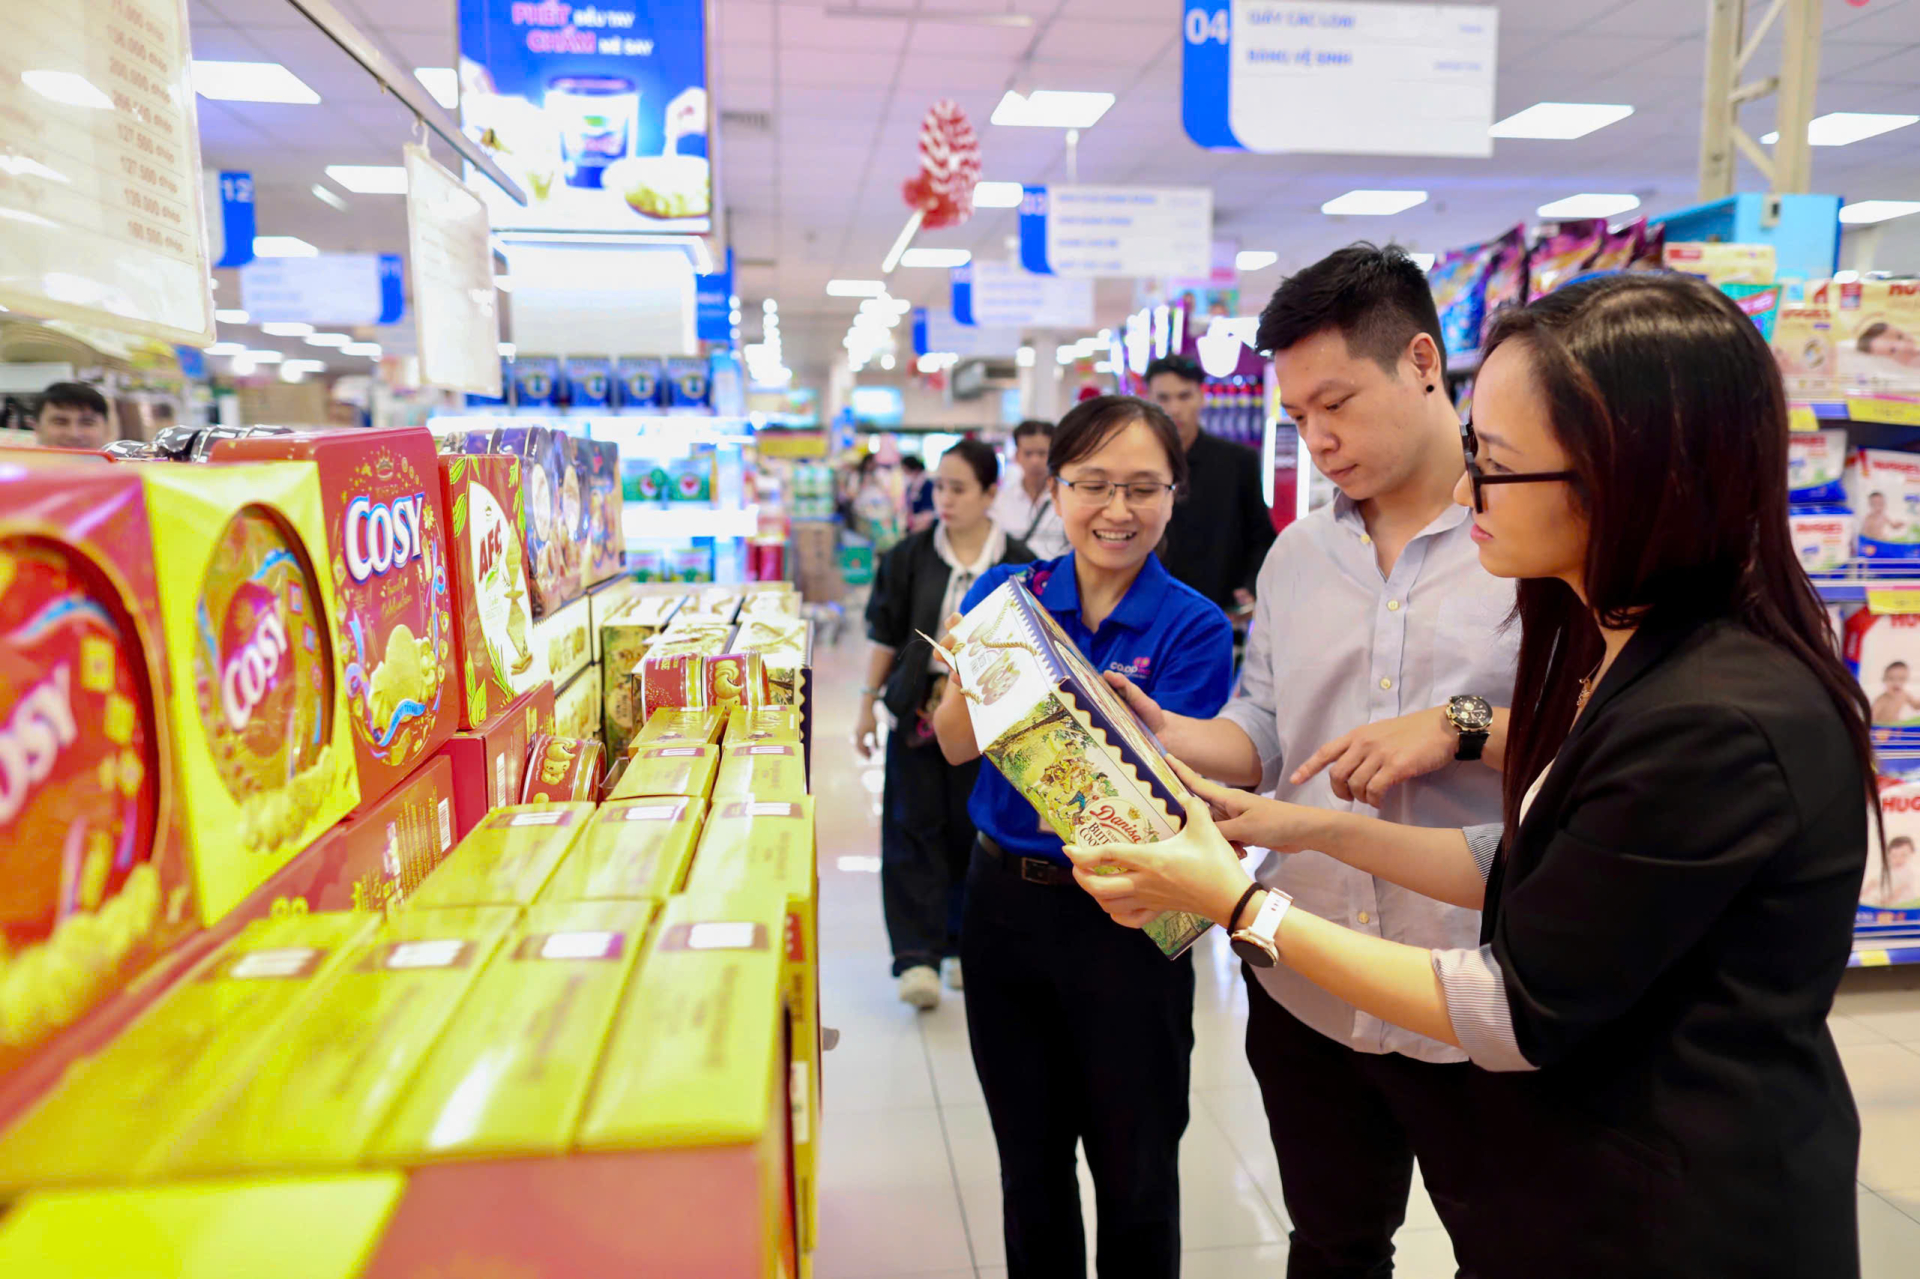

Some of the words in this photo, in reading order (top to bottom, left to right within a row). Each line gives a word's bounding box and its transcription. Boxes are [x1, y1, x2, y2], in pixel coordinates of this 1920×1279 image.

[1184, 9, 1229, 44] 04
[222, 178, 252, 203] 12
[345, 490, 425, 584] COSY
[478, 518, 503, 583] AFC
[222, 611, 288, 731] COSY
[1079, 826, 1101, 847] COO
[1088, 821, 1113, 846] BUTT
[1089, 804, 1142, 845] Danisa
